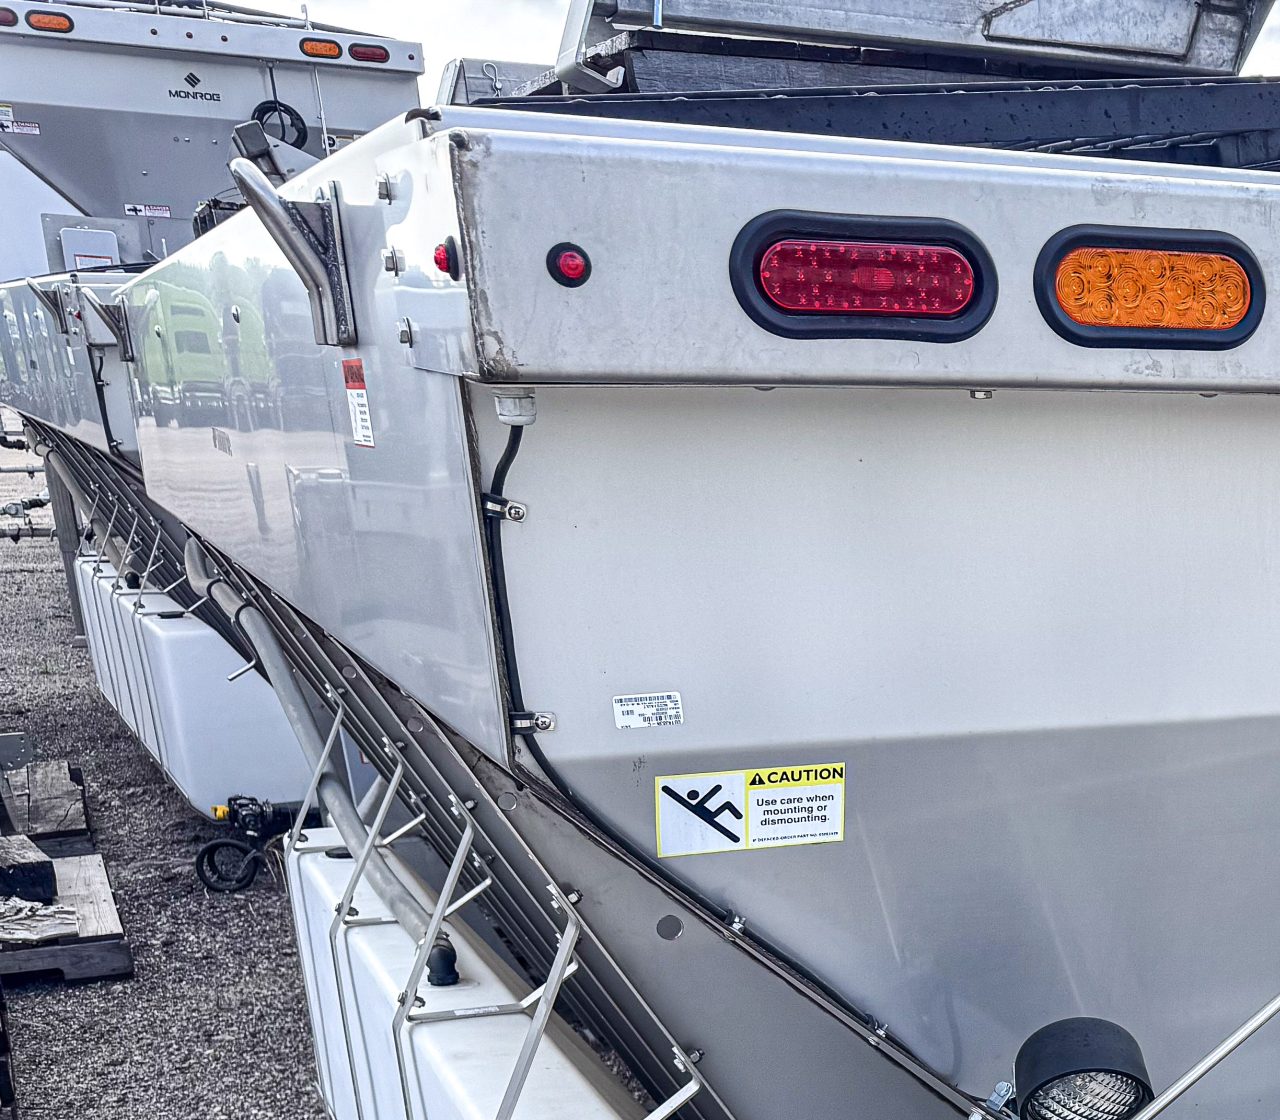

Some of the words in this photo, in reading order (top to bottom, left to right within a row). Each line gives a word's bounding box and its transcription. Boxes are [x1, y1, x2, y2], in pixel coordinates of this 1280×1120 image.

[168, 89, 221, 102] MONROE
[767, 767, 844, 784] CAUTION
[756, 798, 778, 807] Use
[780, 797, 803, 805] care
[806, 794, 834, 803] when
[763, 805, 814, 816] mounting
[816, 804, 828, 812] or
[760, 814, 830, 826] dismounting.
